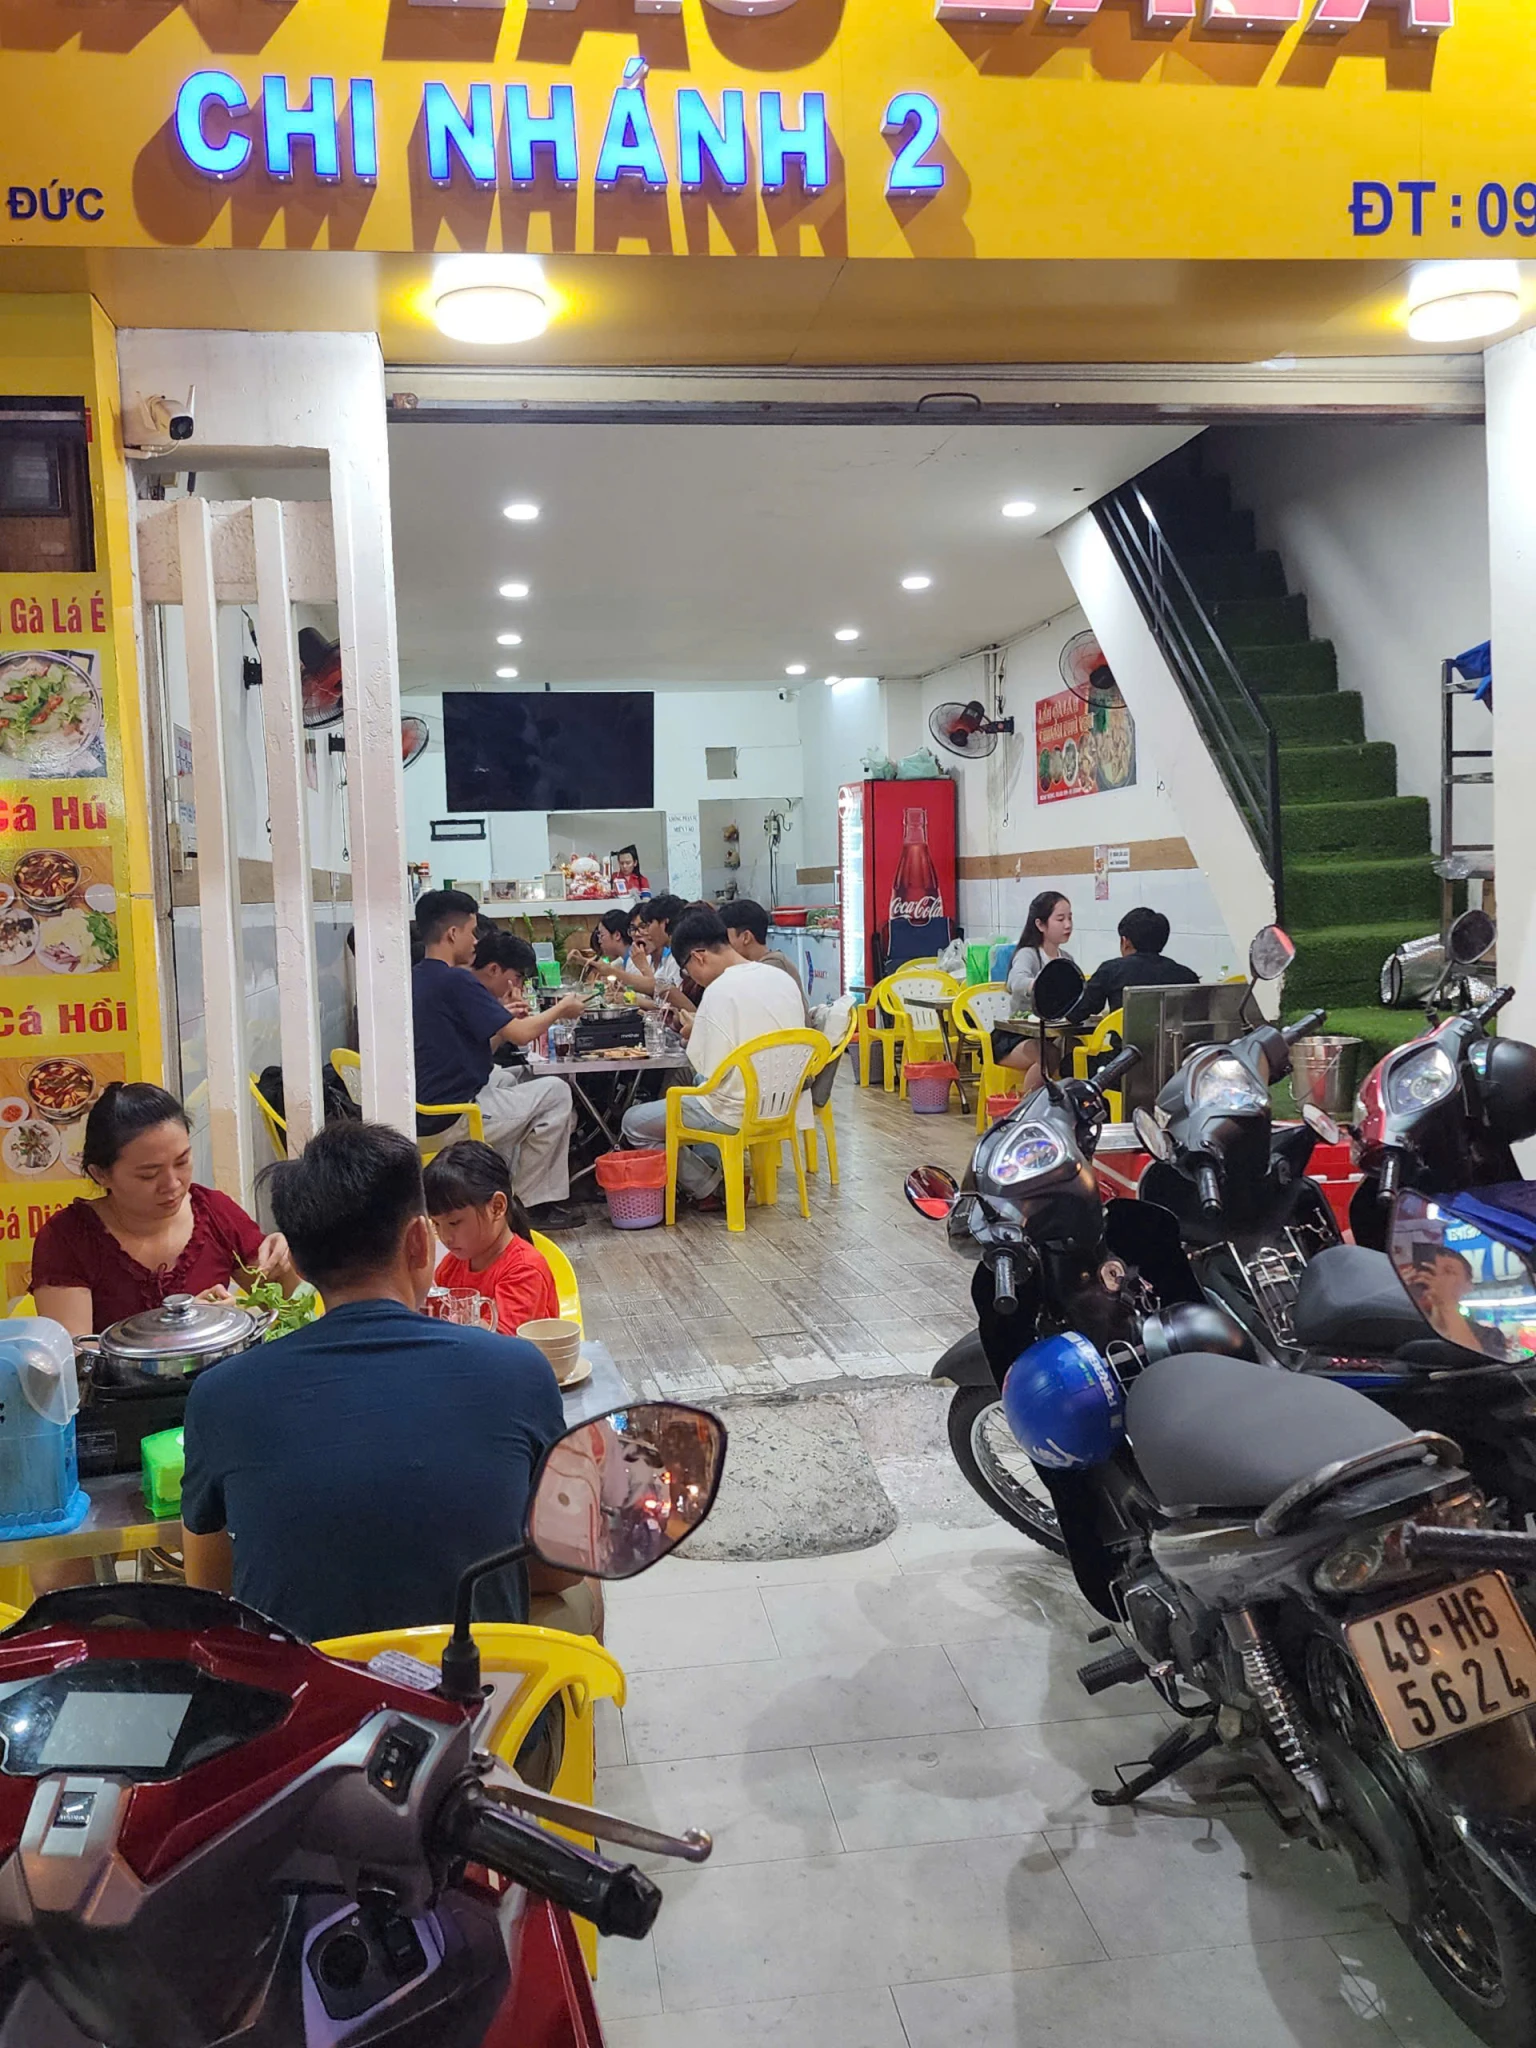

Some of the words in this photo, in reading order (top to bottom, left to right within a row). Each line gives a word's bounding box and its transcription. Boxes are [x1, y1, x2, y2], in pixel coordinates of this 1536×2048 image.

[176, 69, 379, 183] CHI
[424, 56, 830, 191] NHÁNH
[883, 92, 945, 193] 2
[6, 178, 105, 221] ĐỨC
[10, 596, 44, 634] Gà
[52, 596, 82, 633] Lá
[90, 590, 107, 633] É
[52, 795, 107, 831] Hú
[891, 895, 942, 919] Coca-Cola
[58, 997, 128, 1034] Hồi
[1397, 1647, 1530, 1737] 5624
